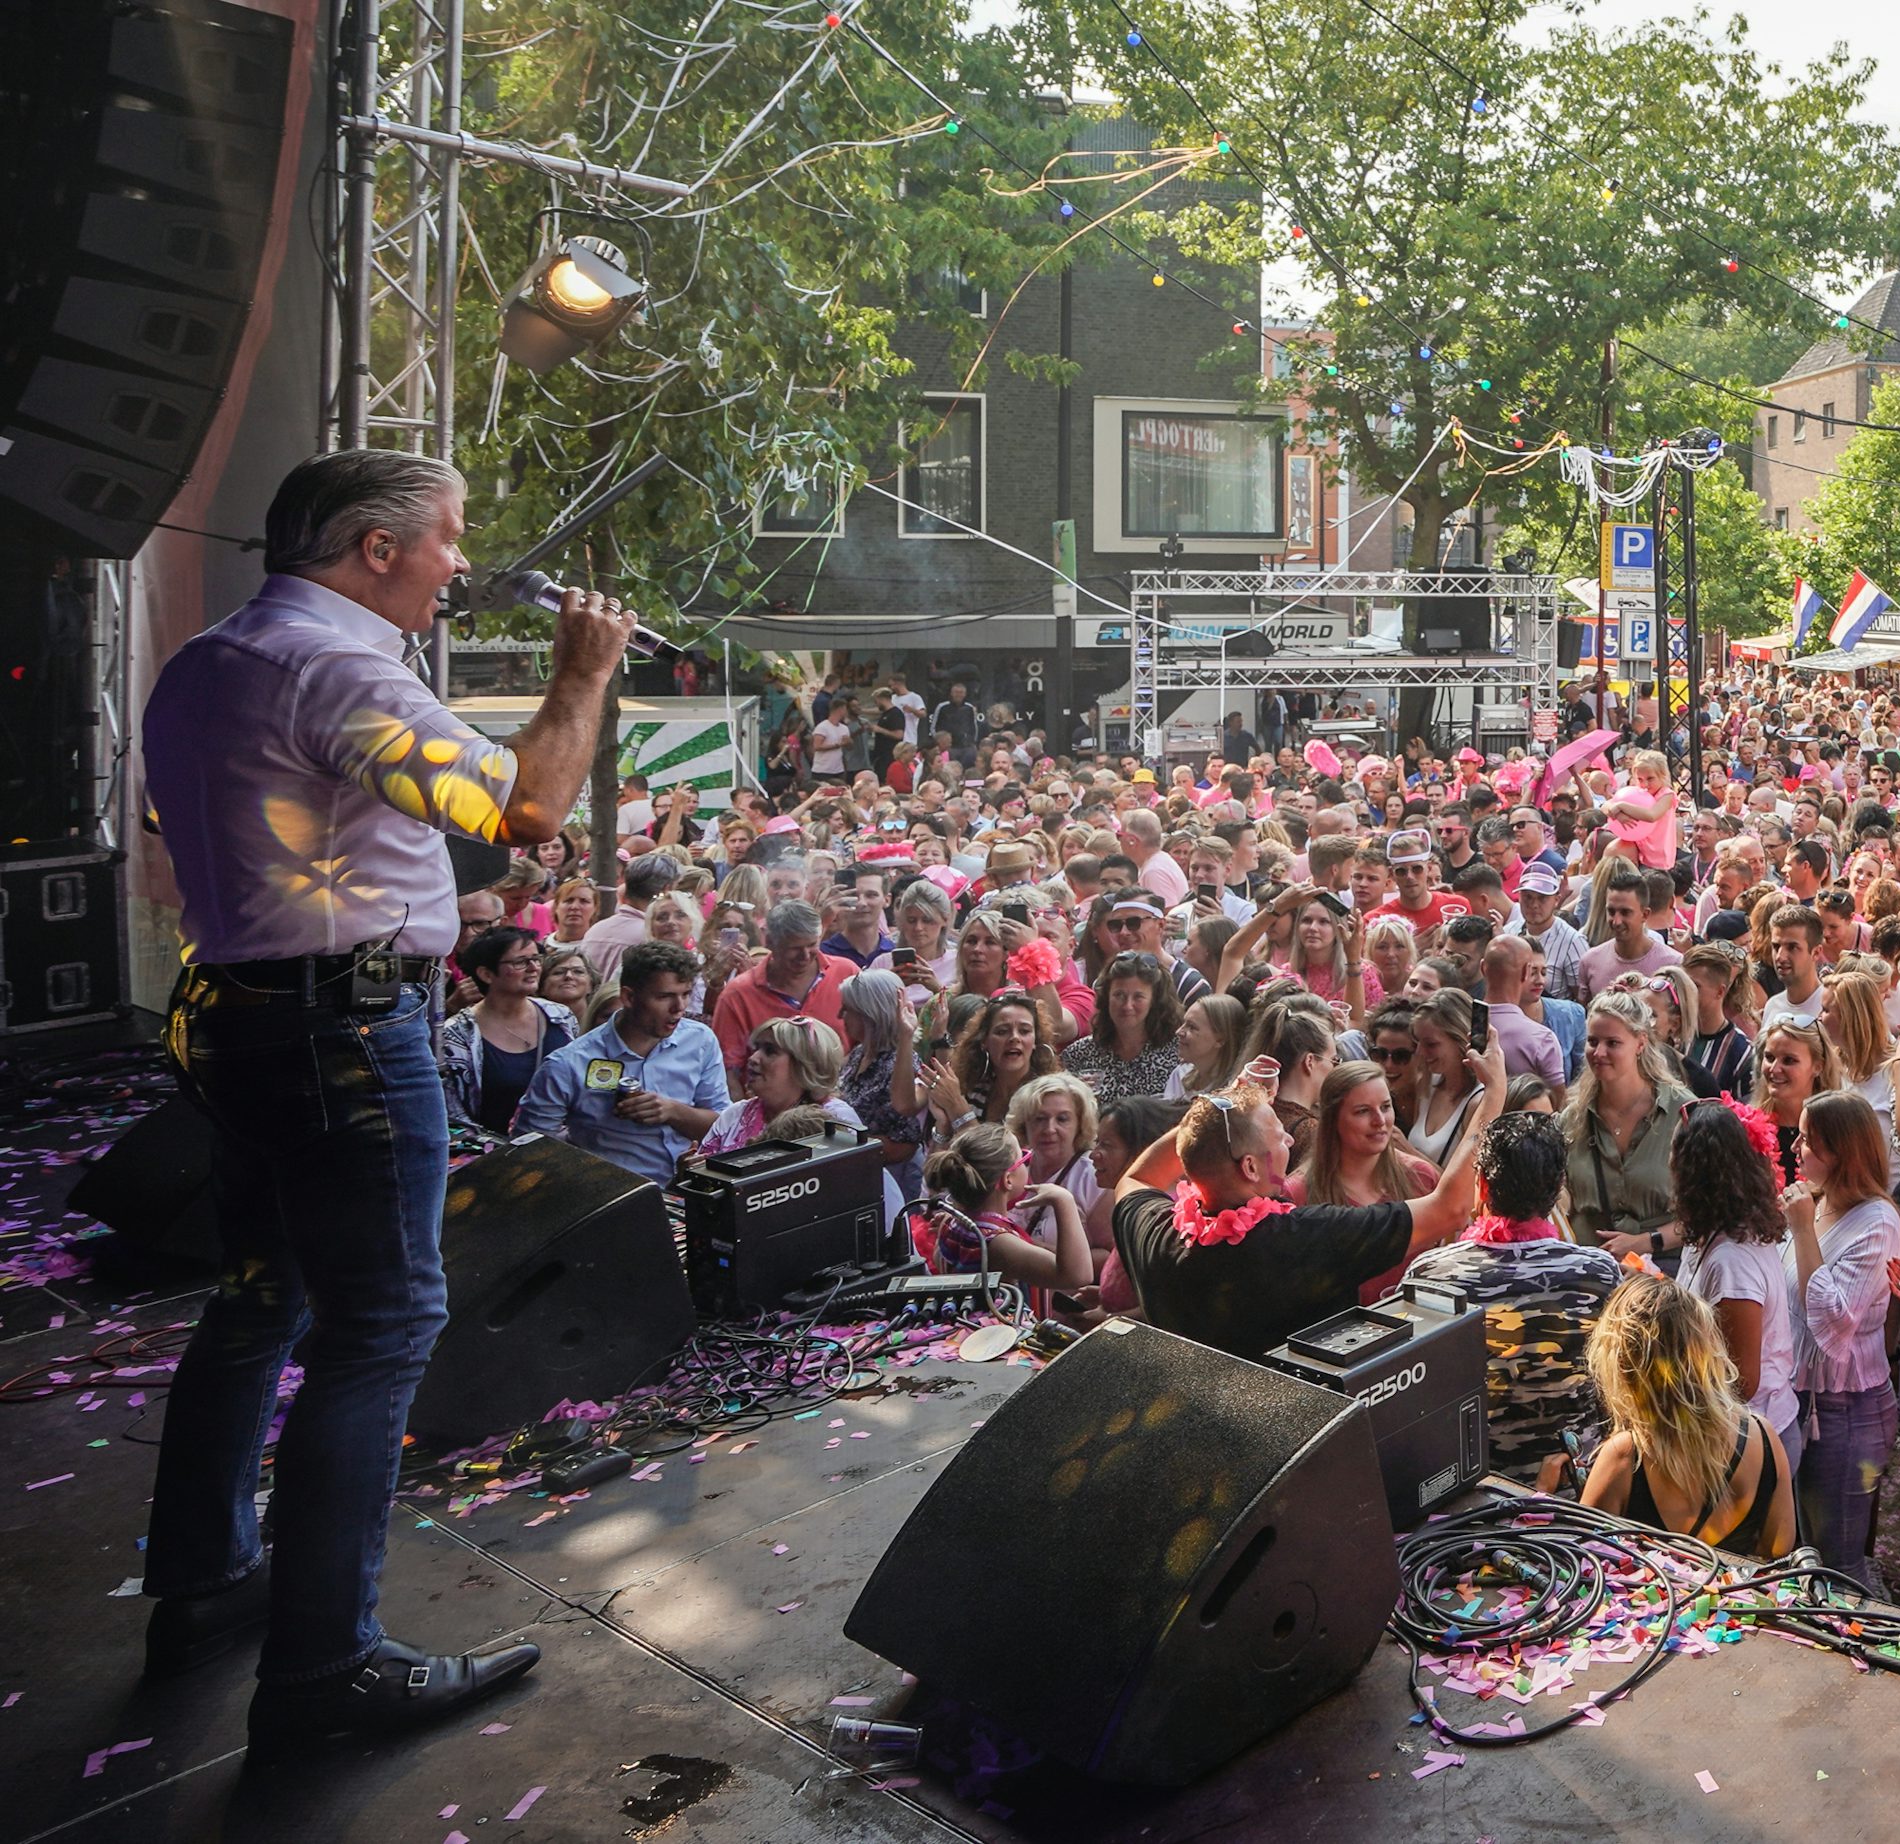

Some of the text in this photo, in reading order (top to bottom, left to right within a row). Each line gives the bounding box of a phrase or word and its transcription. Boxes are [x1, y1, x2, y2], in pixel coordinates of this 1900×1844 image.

[1622, 531, 1647, 564] P
[745, 1177, 820, 1214] S2500
[1355, 1361, 1427, 1408] S2500
